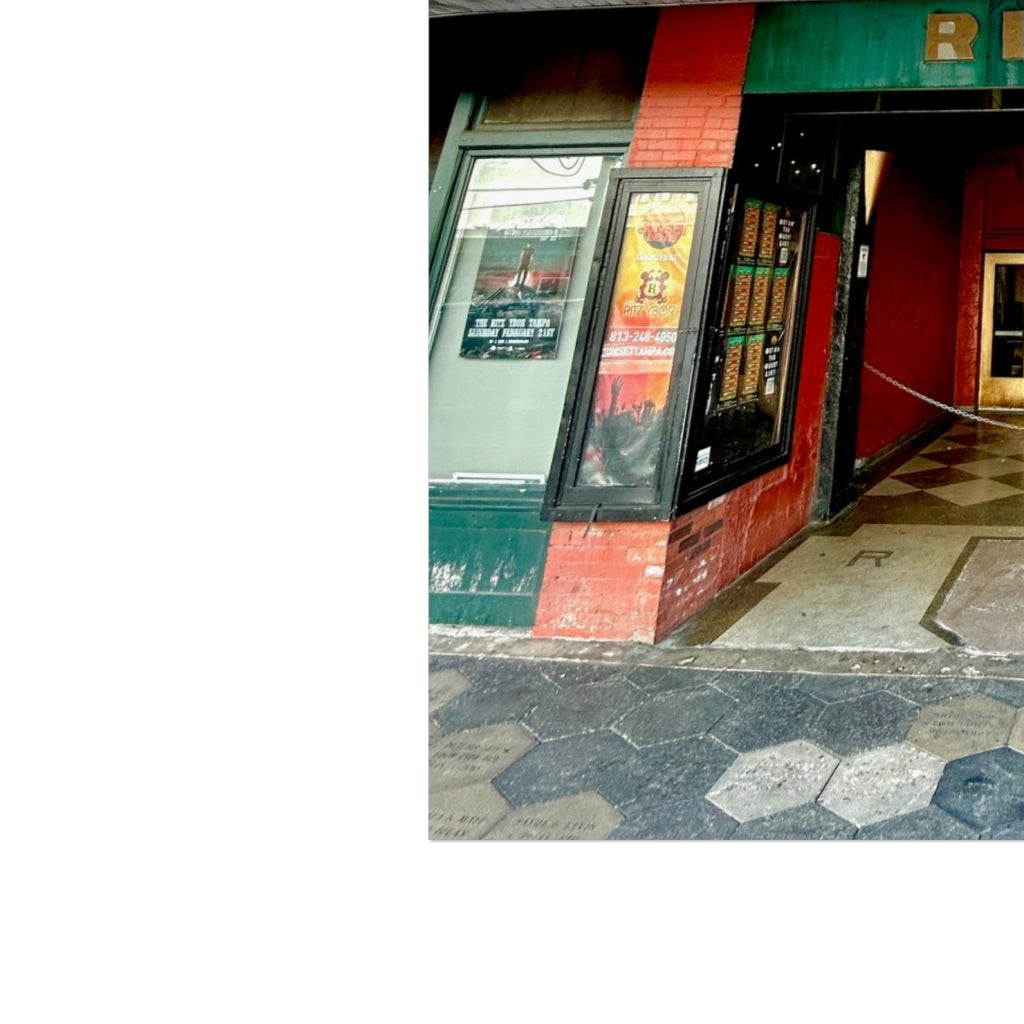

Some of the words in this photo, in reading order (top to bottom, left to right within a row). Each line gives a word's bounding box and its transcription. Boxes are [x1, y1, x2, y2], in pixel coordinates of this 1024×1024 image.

[623, 305, 643, 317] RITZ
[646, 305, 676, 318] YBOR
[475, 319, 488, 328] THE
[491, 319, 505, 328] RITZ
[529, 319, 551, 328] TAMPA
[467, 328, 500, 338] SATURDAY
[502, 328, 535, 338] FEBRUARY
[538, 328, 555, 337] 21ST
[609, 331, 677, 344] 813-248-4050
[846, 549, 894, 568] R
